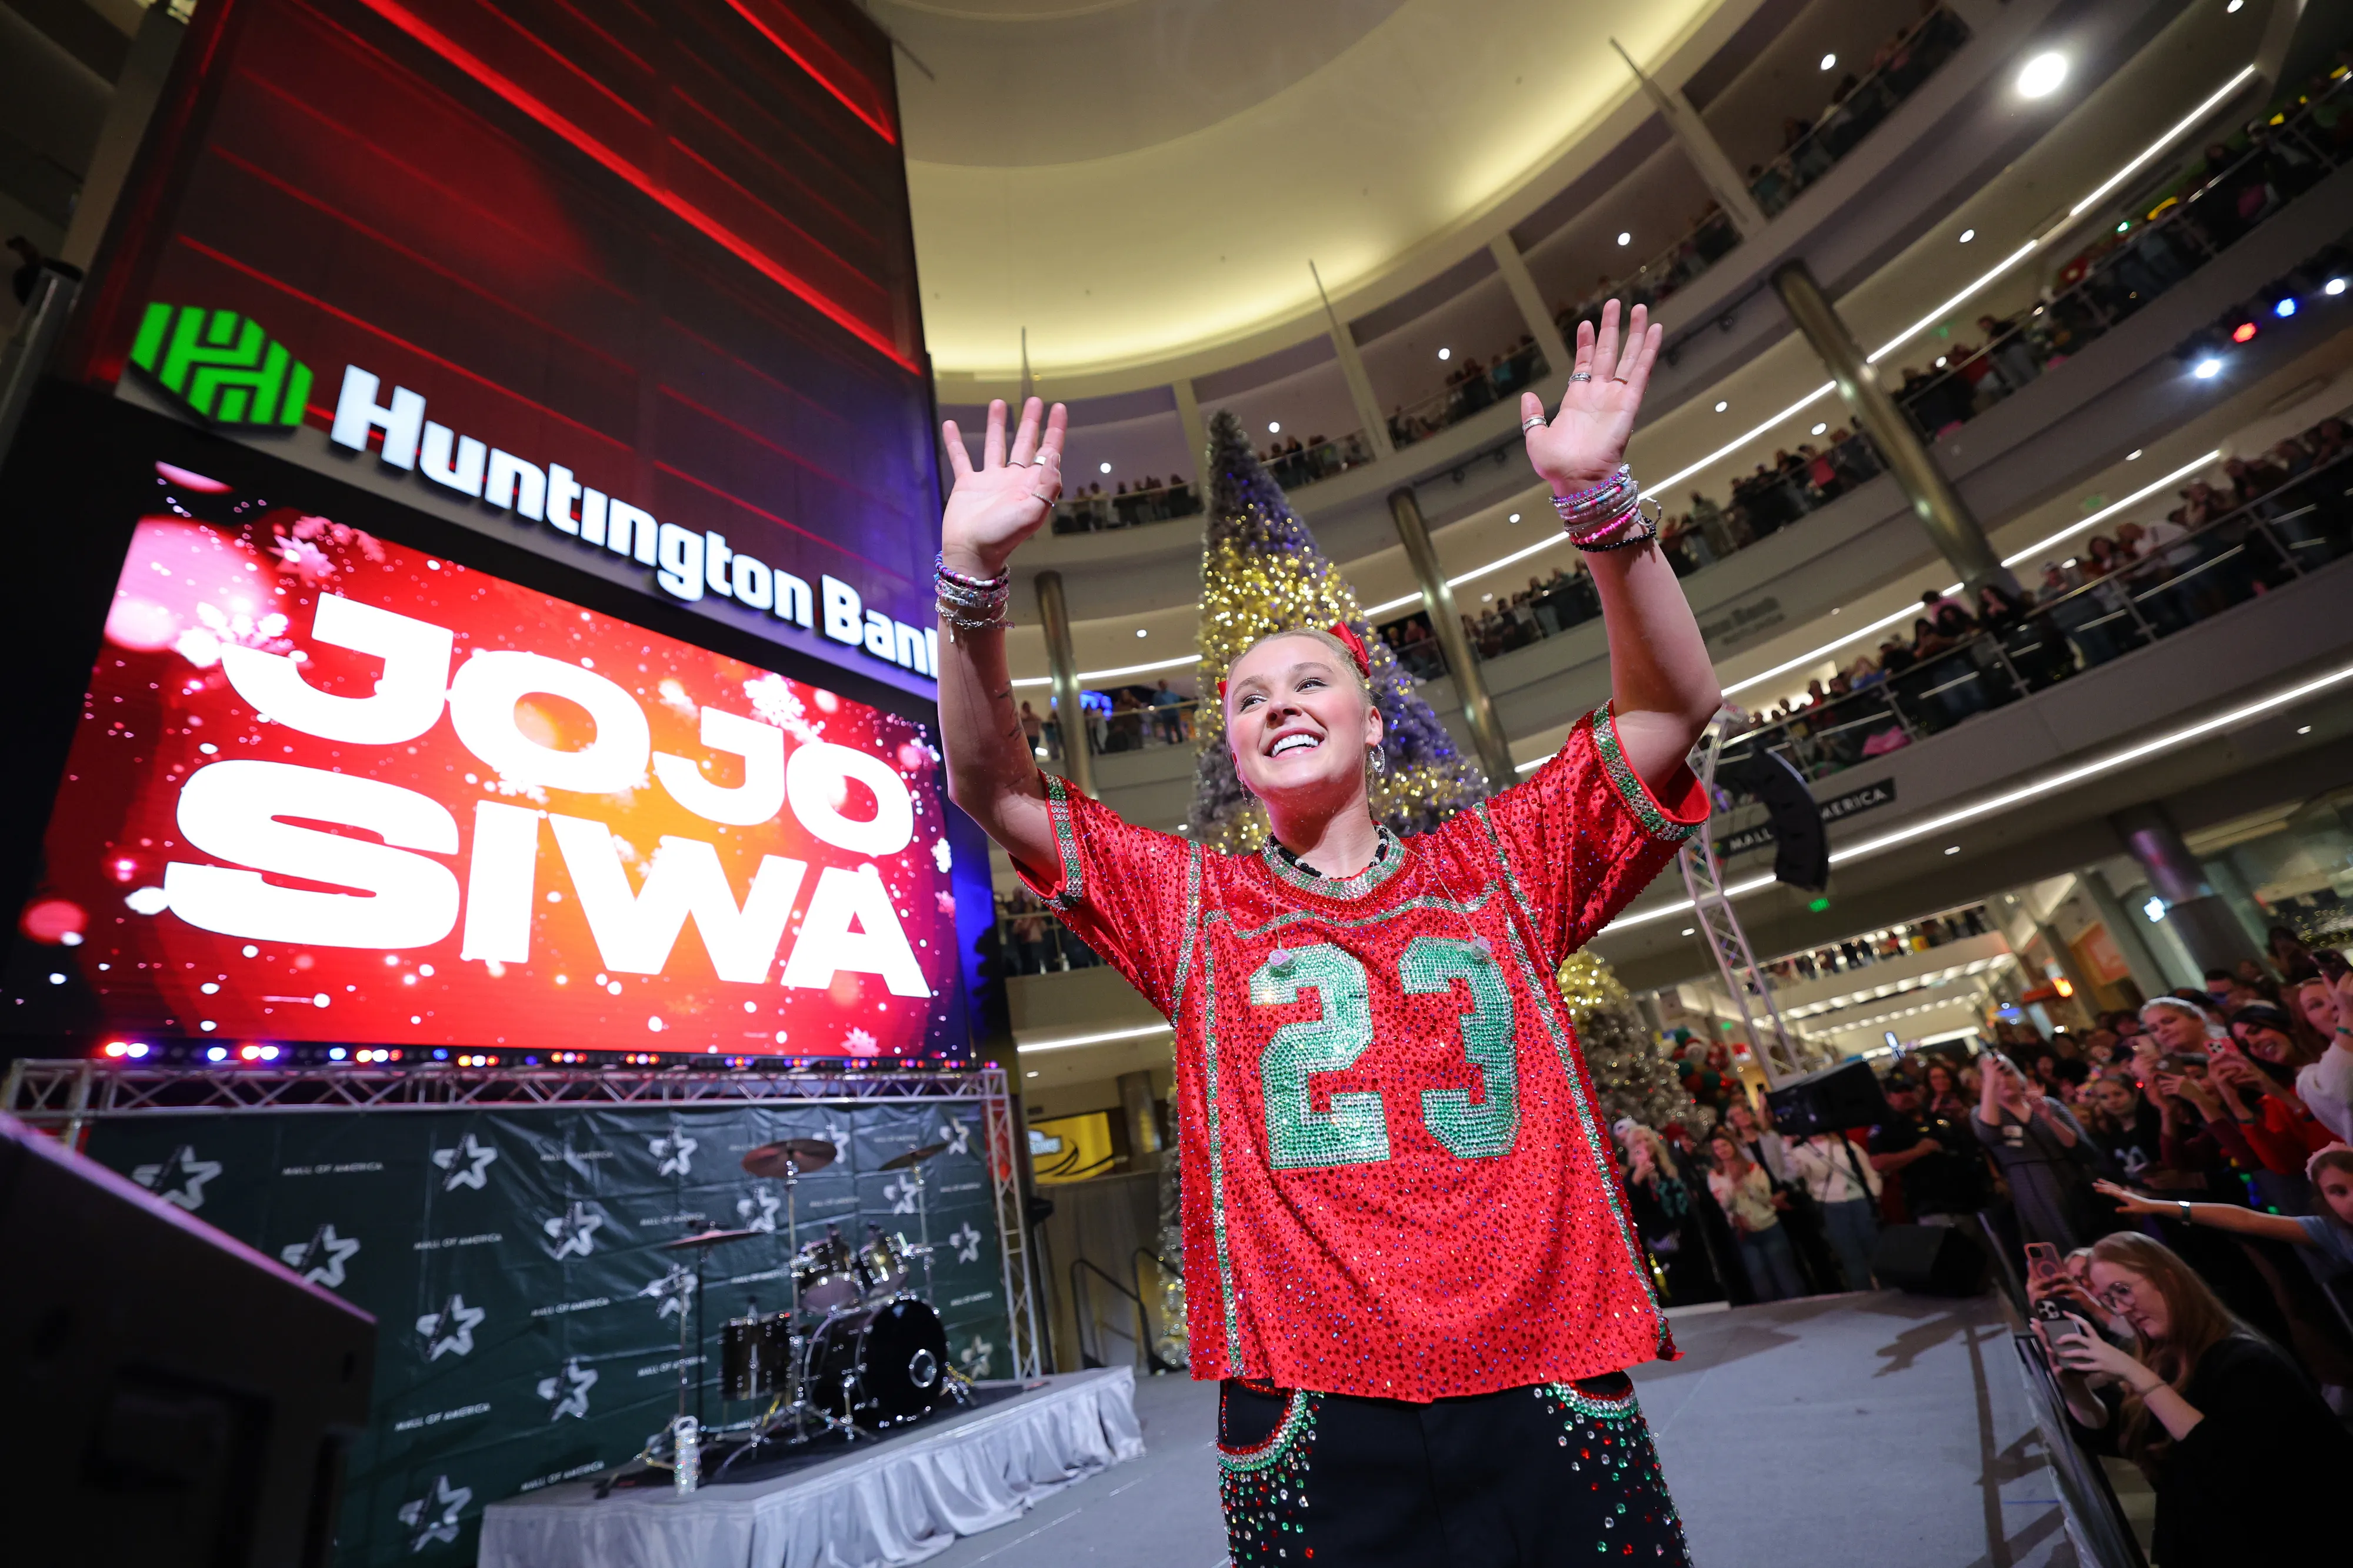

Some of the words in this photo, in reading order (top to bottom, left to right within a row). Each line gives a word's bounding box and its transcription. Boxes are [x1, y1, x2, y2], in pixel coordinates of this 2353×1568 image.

[331, 364, 813, 629] Huntington
[221, 592, 914, 855] JOJO
[1731, 829, 1773, 849] MALL
[1821, 789, 1886, 819] MERICA
[164, 759, 931, 998] SIWA
[1249, 936, 1520, 1170] 23
